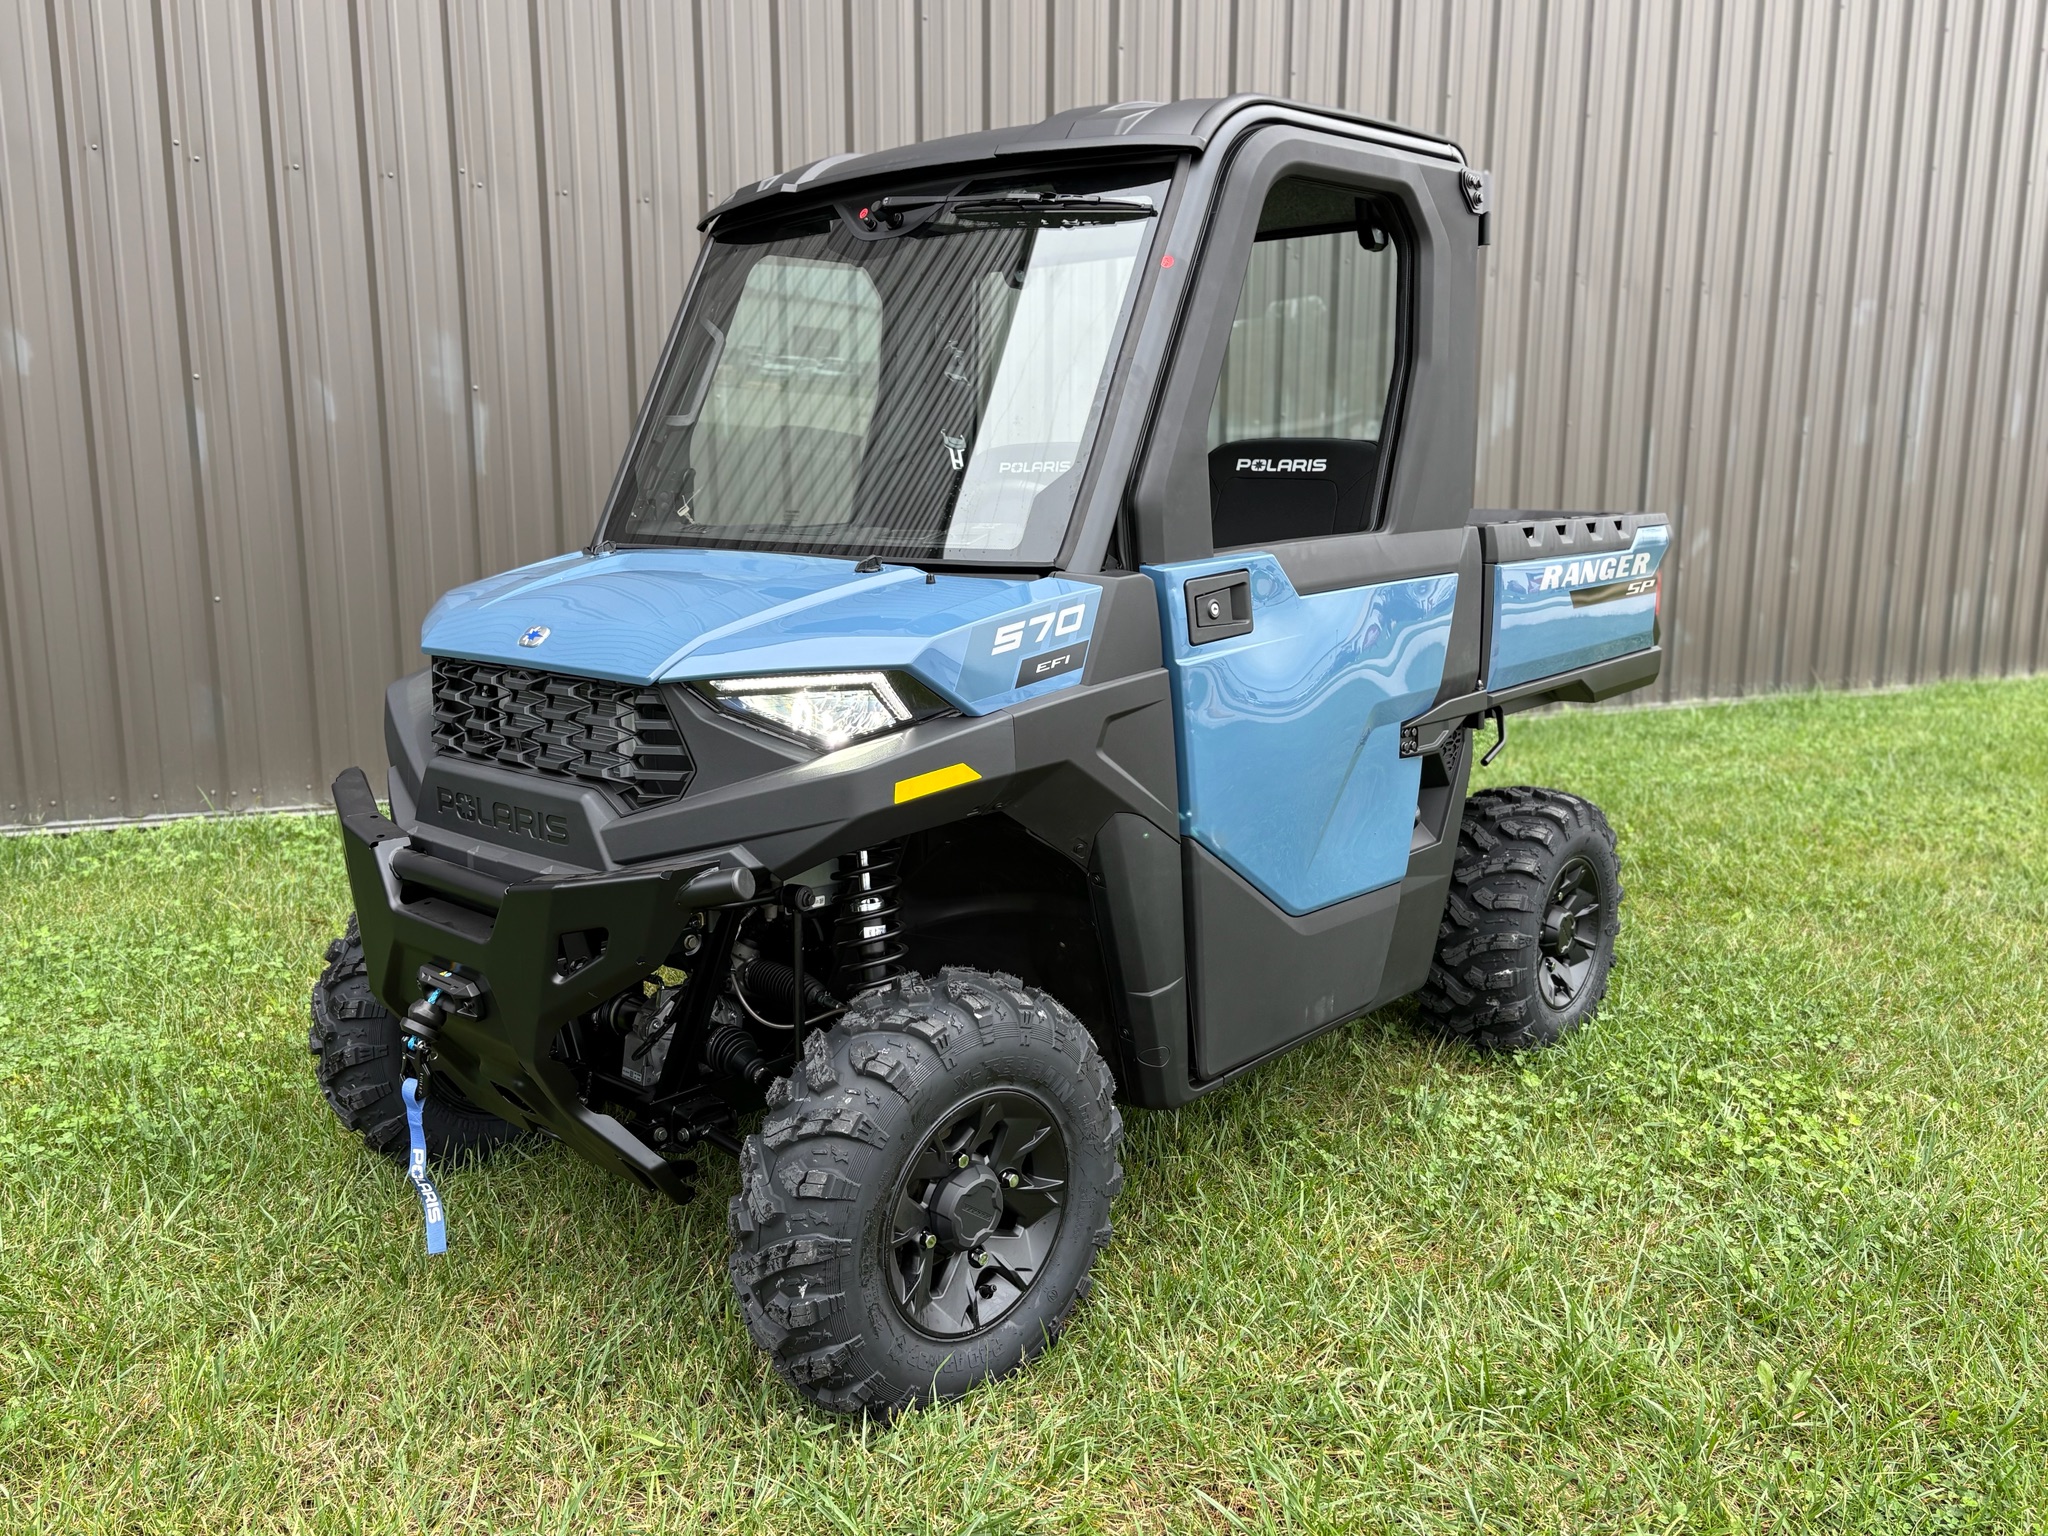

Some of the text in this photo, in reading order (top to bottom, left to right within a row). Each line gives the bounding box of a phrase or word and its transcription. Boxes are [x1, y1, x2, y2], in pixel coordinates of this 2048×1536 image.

[999, 461, 1071, 473] POLARIS
[1235, 458, 1327, 472] POLARIS
[1540, 552, 1652, 591] RANGER
[1625, 579, 1656, 595] SP
[991, 604, 1086, 656] 570
[1036, 655, 1071, 674] EFI
[437, 786, 570, 847] POLARIS
[411, 1148, 442, 1224] POLARIS
